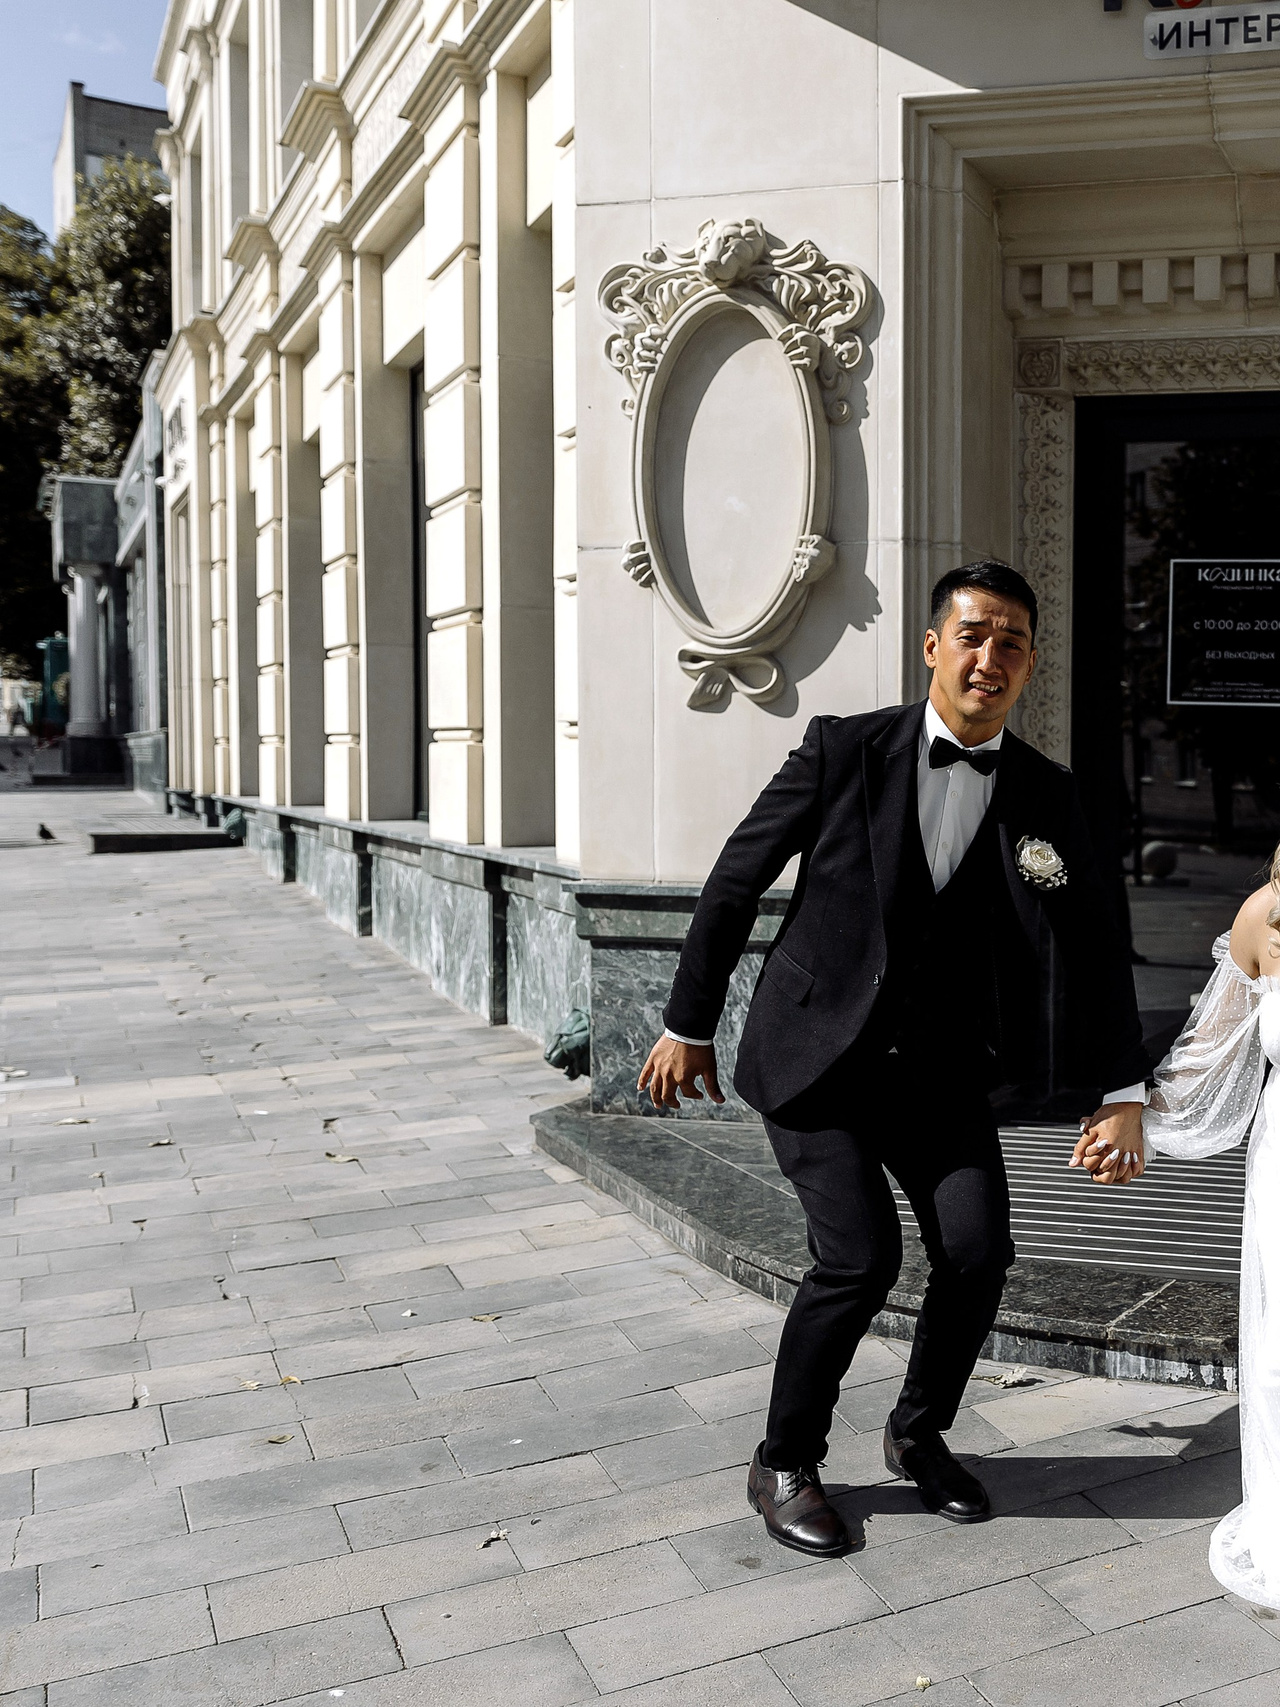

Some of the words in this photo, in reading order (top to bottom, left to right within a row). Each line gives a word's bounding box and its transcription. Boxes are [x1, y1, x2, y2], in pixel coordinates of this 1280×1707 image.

[1204, 619, 1234, 630] 10:00
[1236, 621, 1251, 631] до
[1205, 650, 1222, 659] БЕЗ
[1223, 650, 1275, 660] ВЫХОДНЫХ
